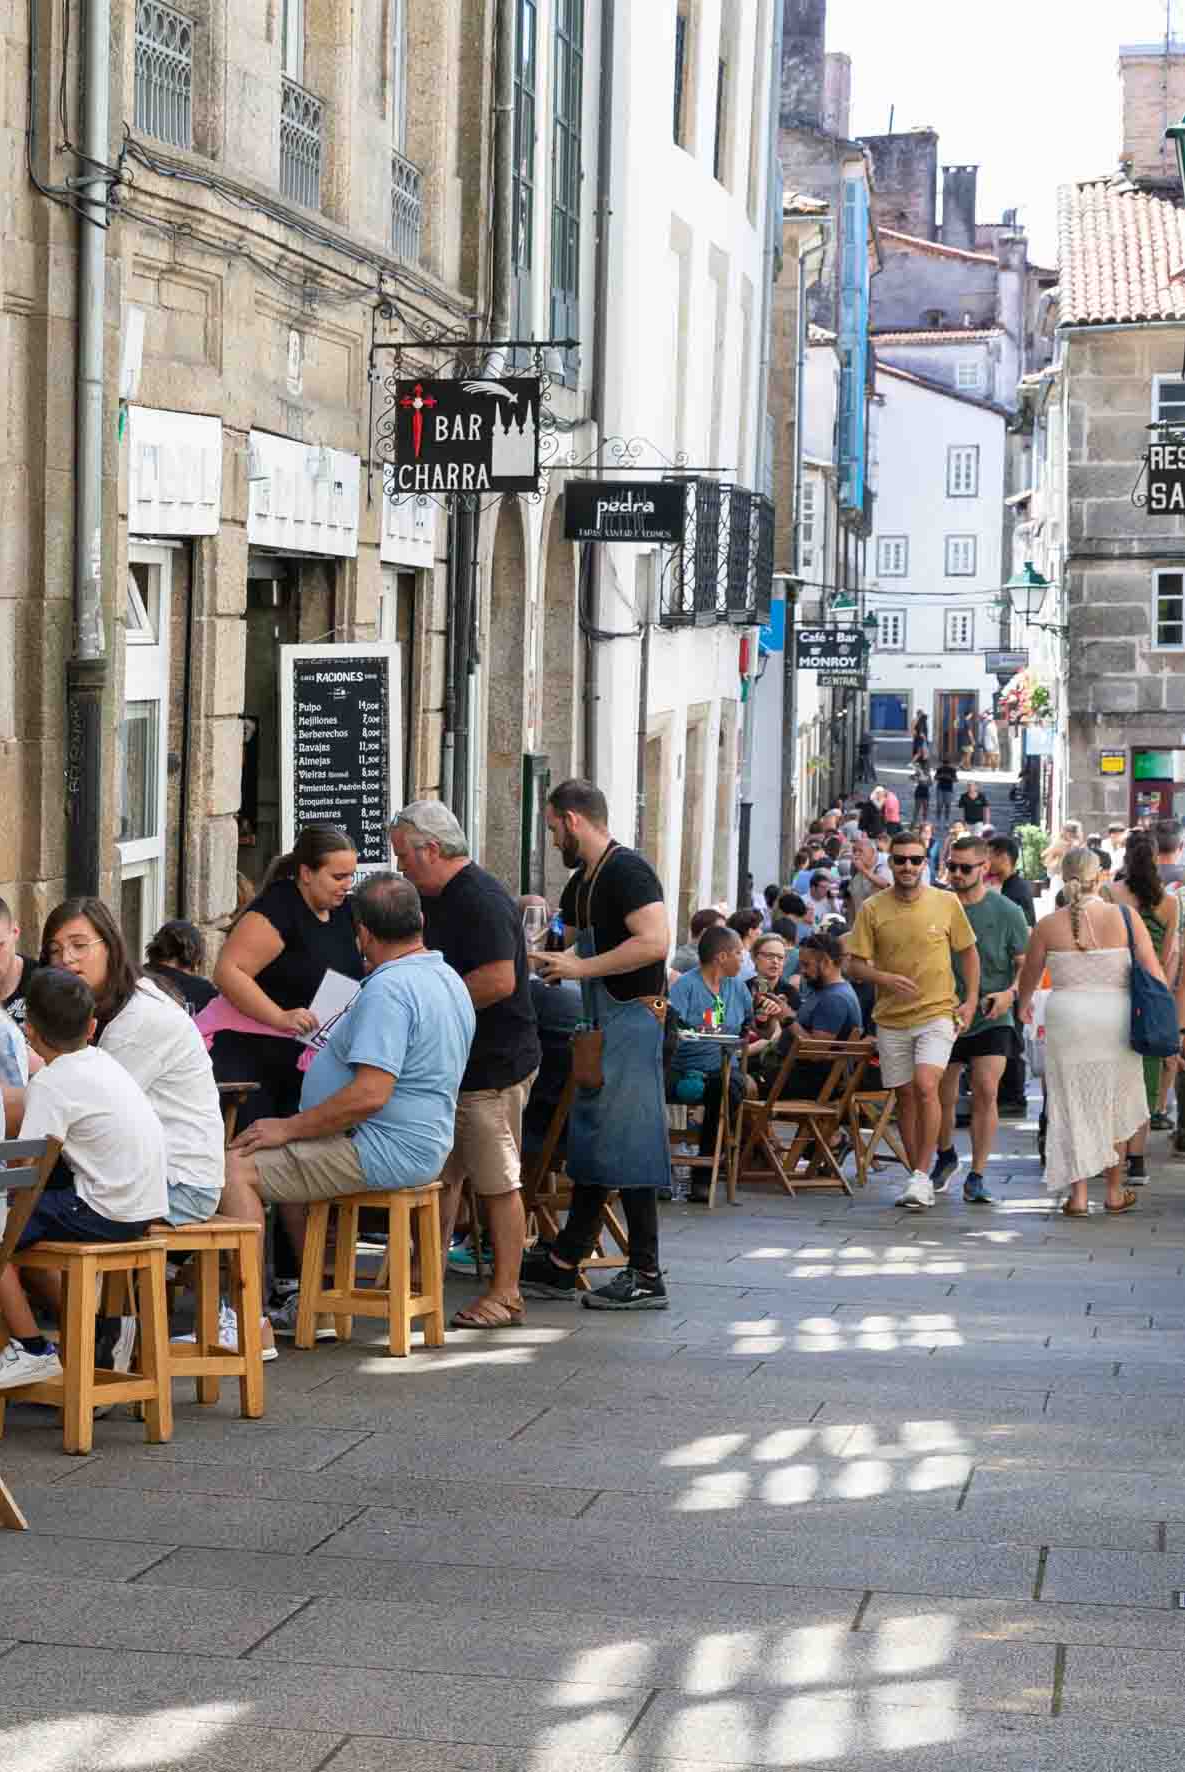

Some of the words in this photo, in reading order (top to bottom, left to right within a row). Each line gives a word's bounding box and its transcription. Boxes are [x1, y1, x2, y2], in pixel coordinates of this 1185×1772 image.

[434, 413, 482, 441] BAR
[398, 463, 492, 491] CHARRA
[1150, 482, 1185, 510] SA
[596, 490, 655, 530] pedra
[799, 631, 826, 642] Café
[836, 632, 858, 643] Bar
[798, 657, 857, 668] MONROY
[315, 671, 364, 683] RACIONES
[298, 702, 322, 714] Pulpo
[298, 715, 338, 727] Mejillones
[298, 728, 349, 739] Berberechos
[298, 756, 331, 767] Almejas
[298, 770, 327, 779] Vieiras
[298, 809, 342, 820] Calamares
